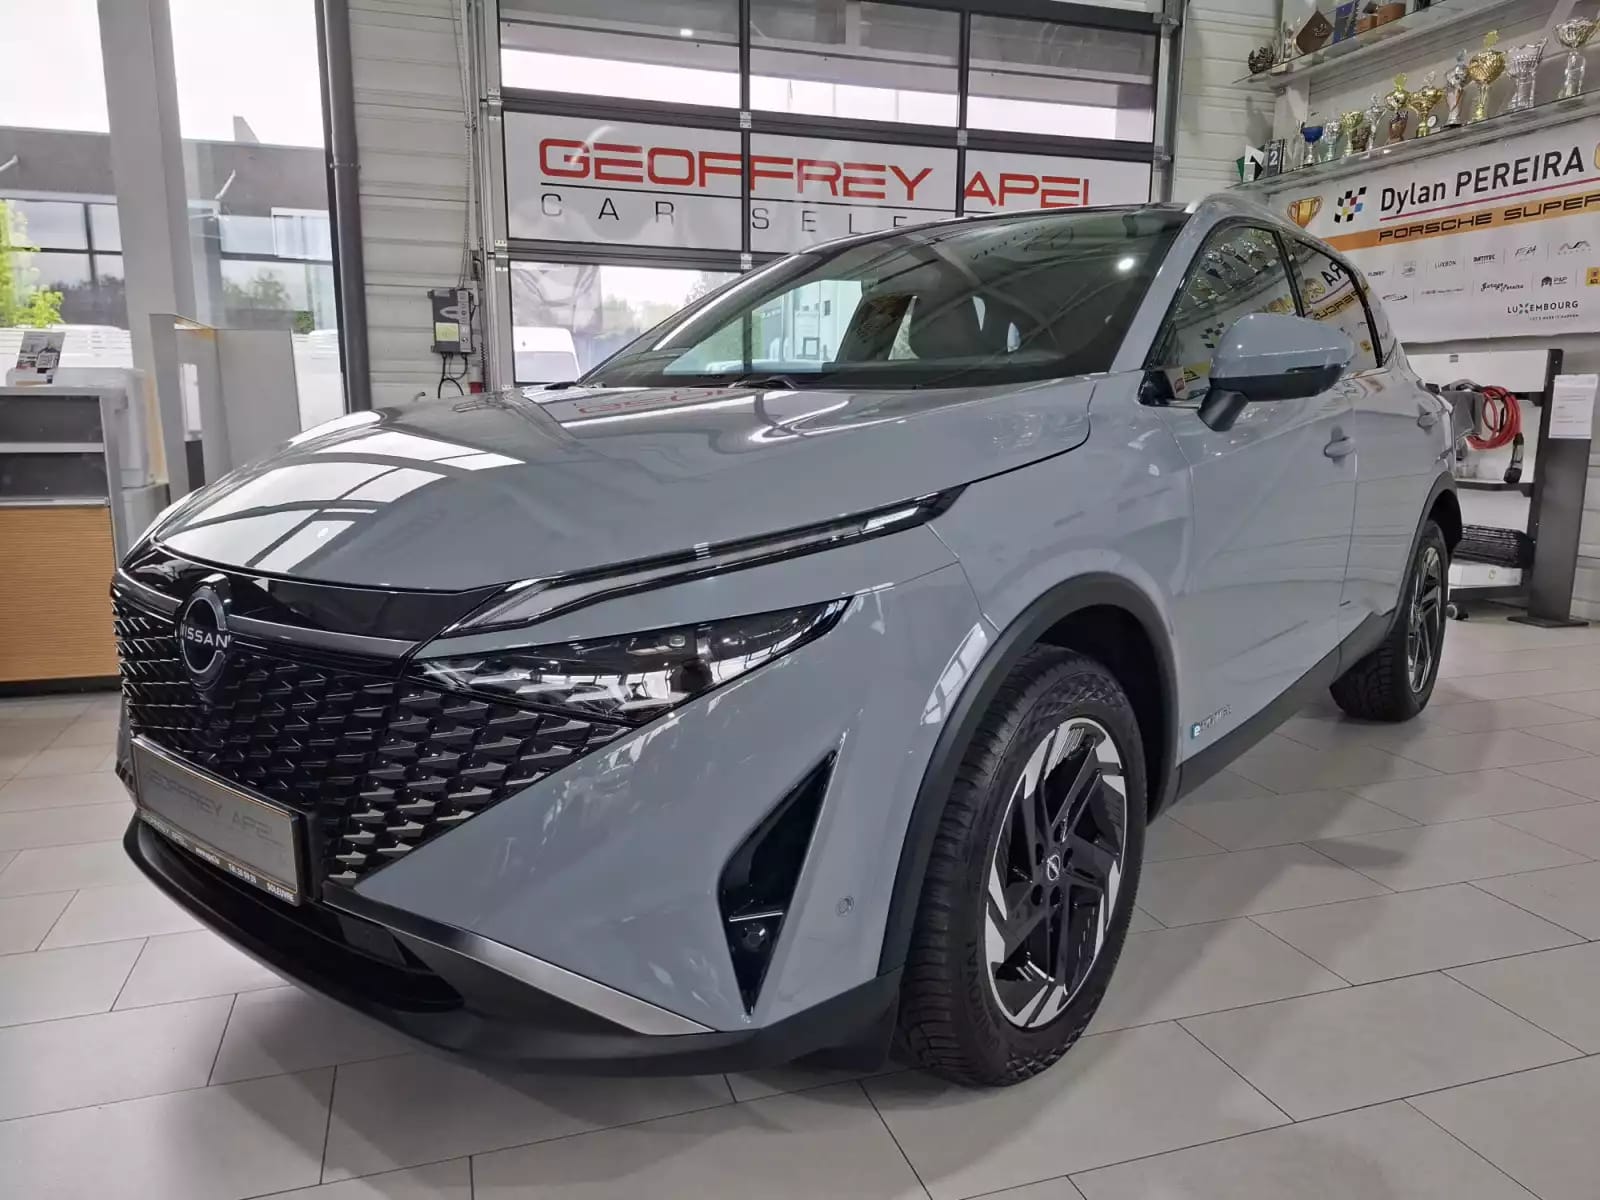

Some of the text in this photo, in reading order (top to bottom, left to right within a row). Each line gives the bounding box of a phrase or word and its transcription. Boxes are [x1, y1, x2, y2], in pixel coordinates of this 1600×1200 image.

[539, 138, 933, 201] GEOFFREY
[1380, 146, 1585, 215] Dylan PEREIRA
[541, 193, 675, 225] CAR
[1378, 212, 1493, 242] PORSCHE
[1507, 300, 1579, 315] LUXEMBOURG
[180, 621, 231, 648] NISSAN
